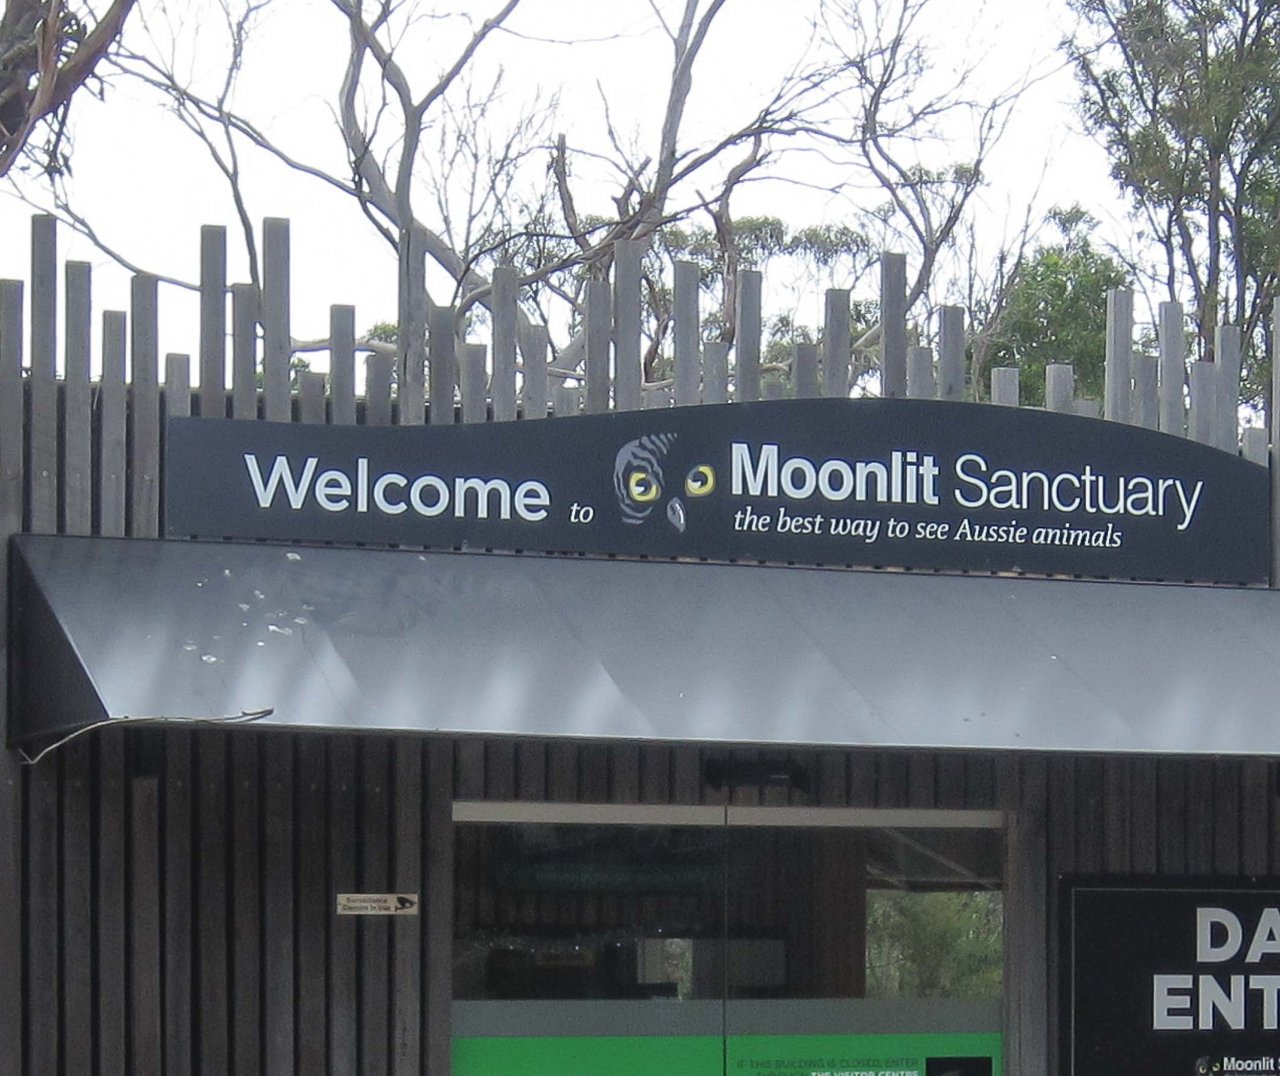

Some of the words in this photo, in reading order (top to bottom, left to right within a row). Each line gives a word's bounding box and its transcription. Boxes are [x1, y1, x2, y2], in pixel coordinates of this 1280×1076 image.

[243, 453, 551, 522] Welcome
[570, 502, 595, 524] to
[731, 442, 939, 505] Moonlit
[954, 453, 1204, 531] Sanctuary
[734, 506, 770, 532] the
[776, 507, 824, 534] best
[830, 516, 880, 543] way
[887, 517, 909, 538] to
[915, 521, 950, 540] see
[954, 518, 1027, 544] Aussie
[1032, 522, 1122, 548] animals
[1223, 1056, 1275, 1071] Moonlit
